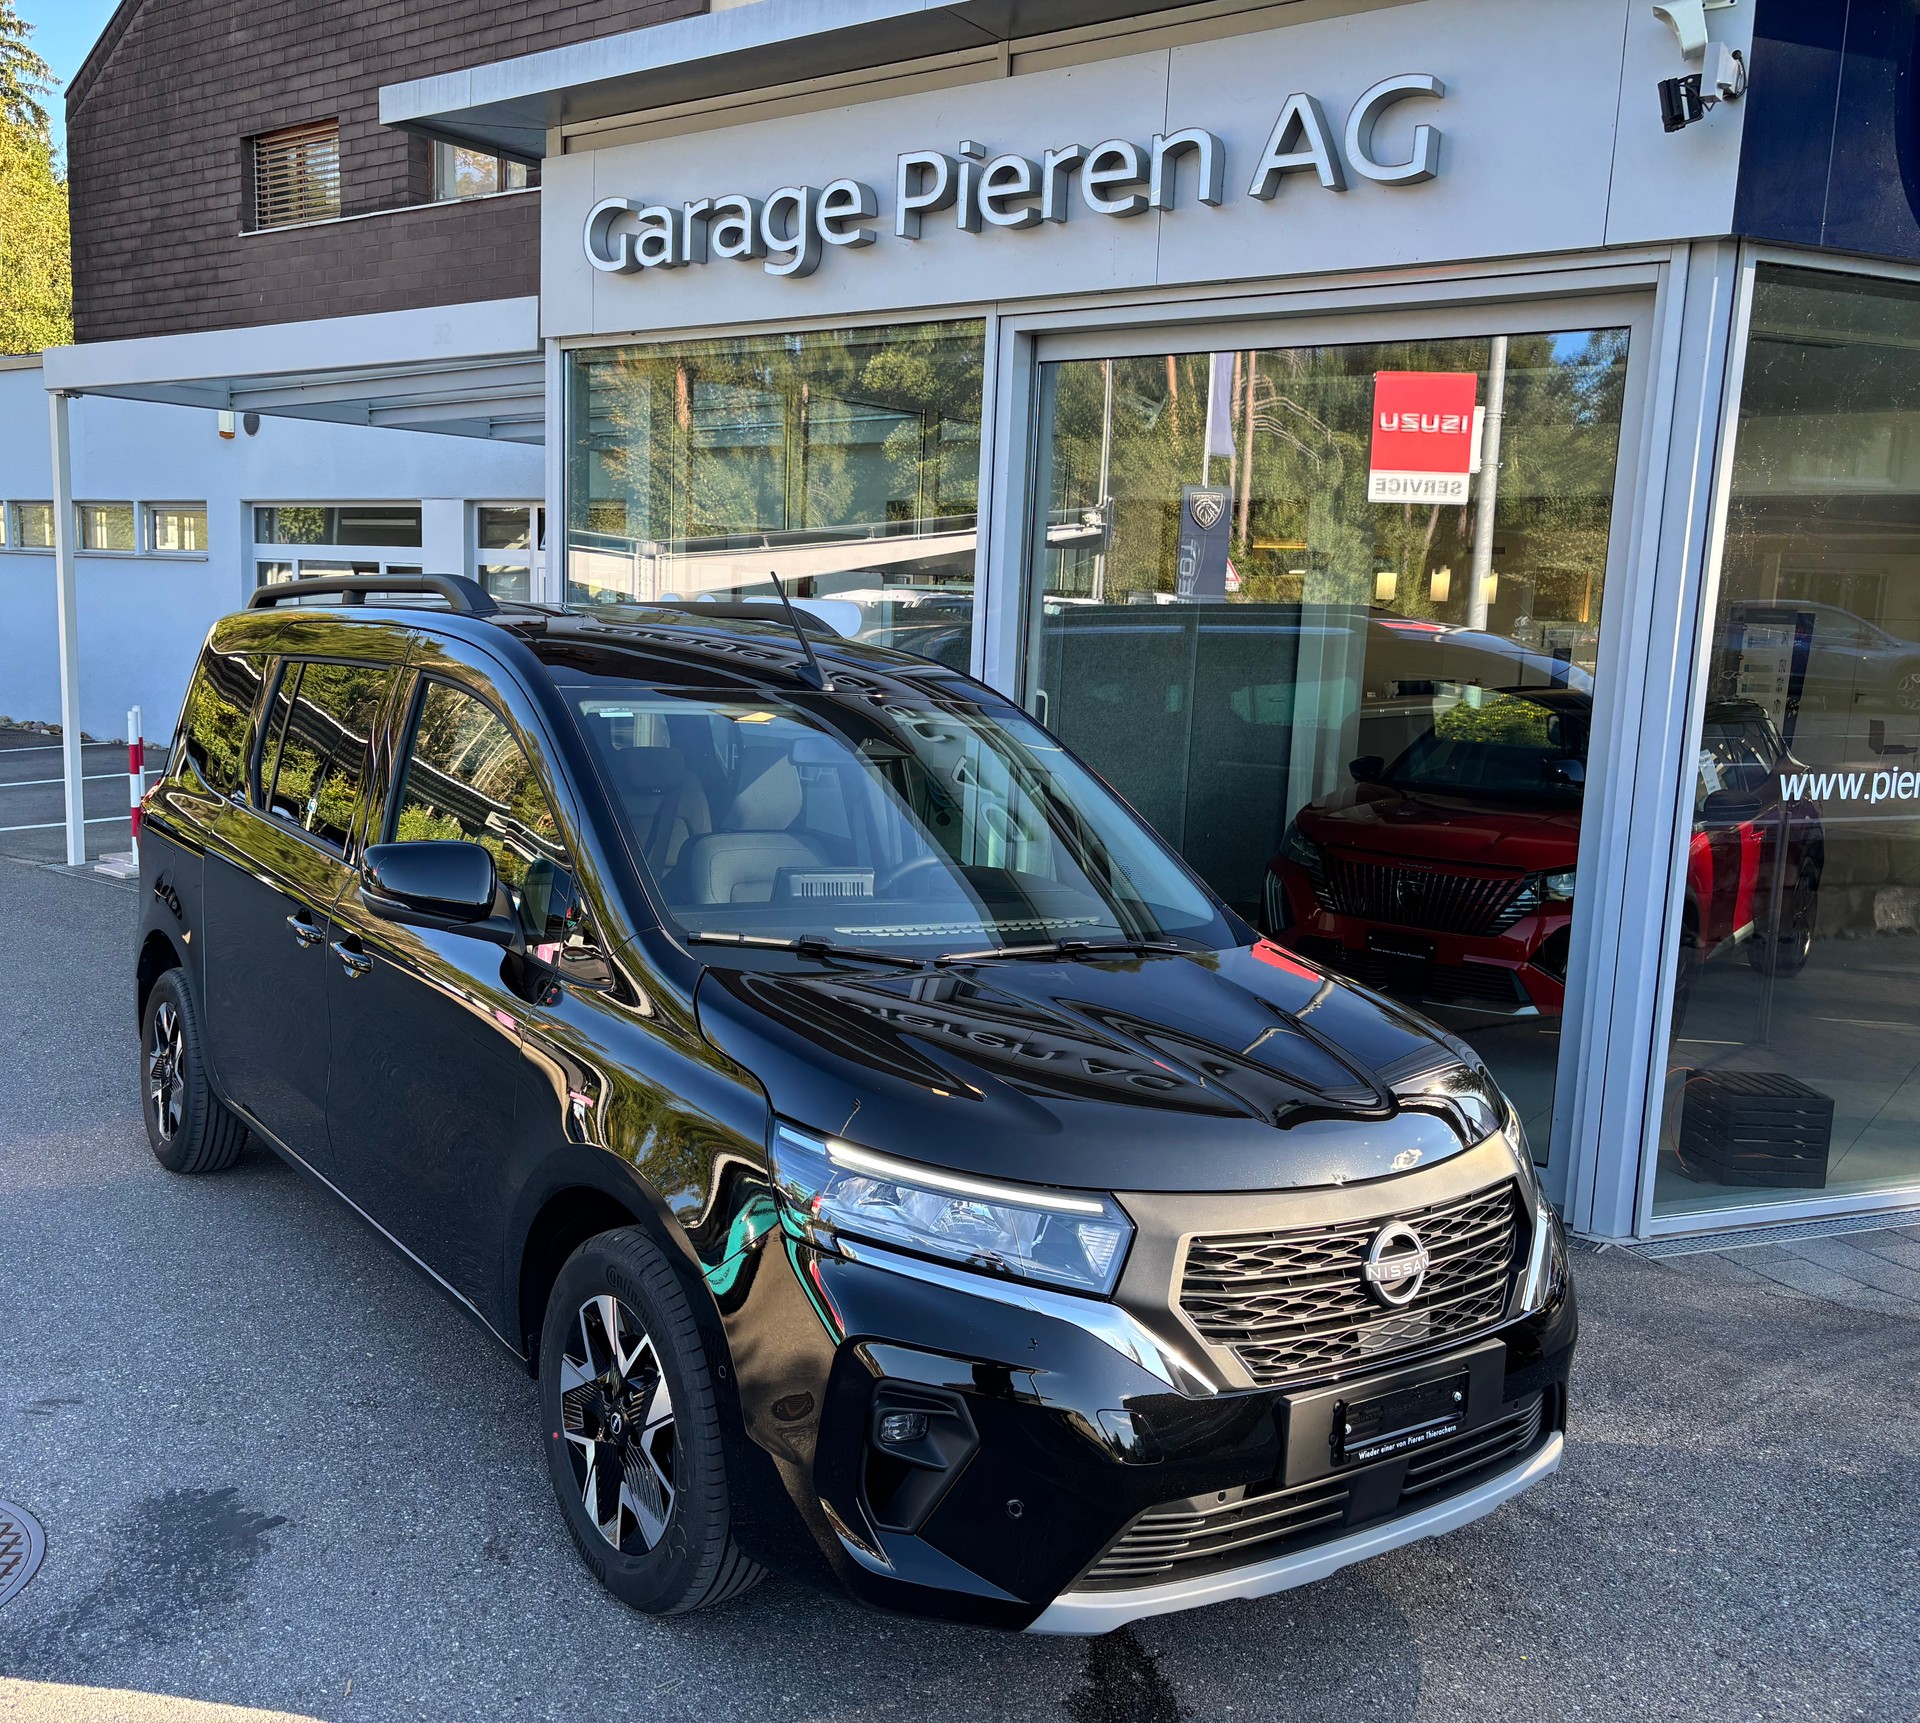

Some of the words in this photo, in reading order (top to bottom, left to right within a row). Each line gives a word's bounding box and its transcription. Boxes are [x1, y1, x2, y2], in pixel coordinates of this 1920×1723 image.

[583, 178, 878, 279] Garage
[895, 127, 1226, 240] Pieren
[1248, 73, 1446, 201] AG
[1368, 1255, 1429, 1280] NISSAN
[1358, 1447, 1380, 1460] Wieder
[1380, 1443, 1396, 1454] einer
[1396, 1440, 1407, 1449] von
[1407, 1434, 1425, 1446] Pieren
[1425, 1424, 1457, 1440] Thierachern
